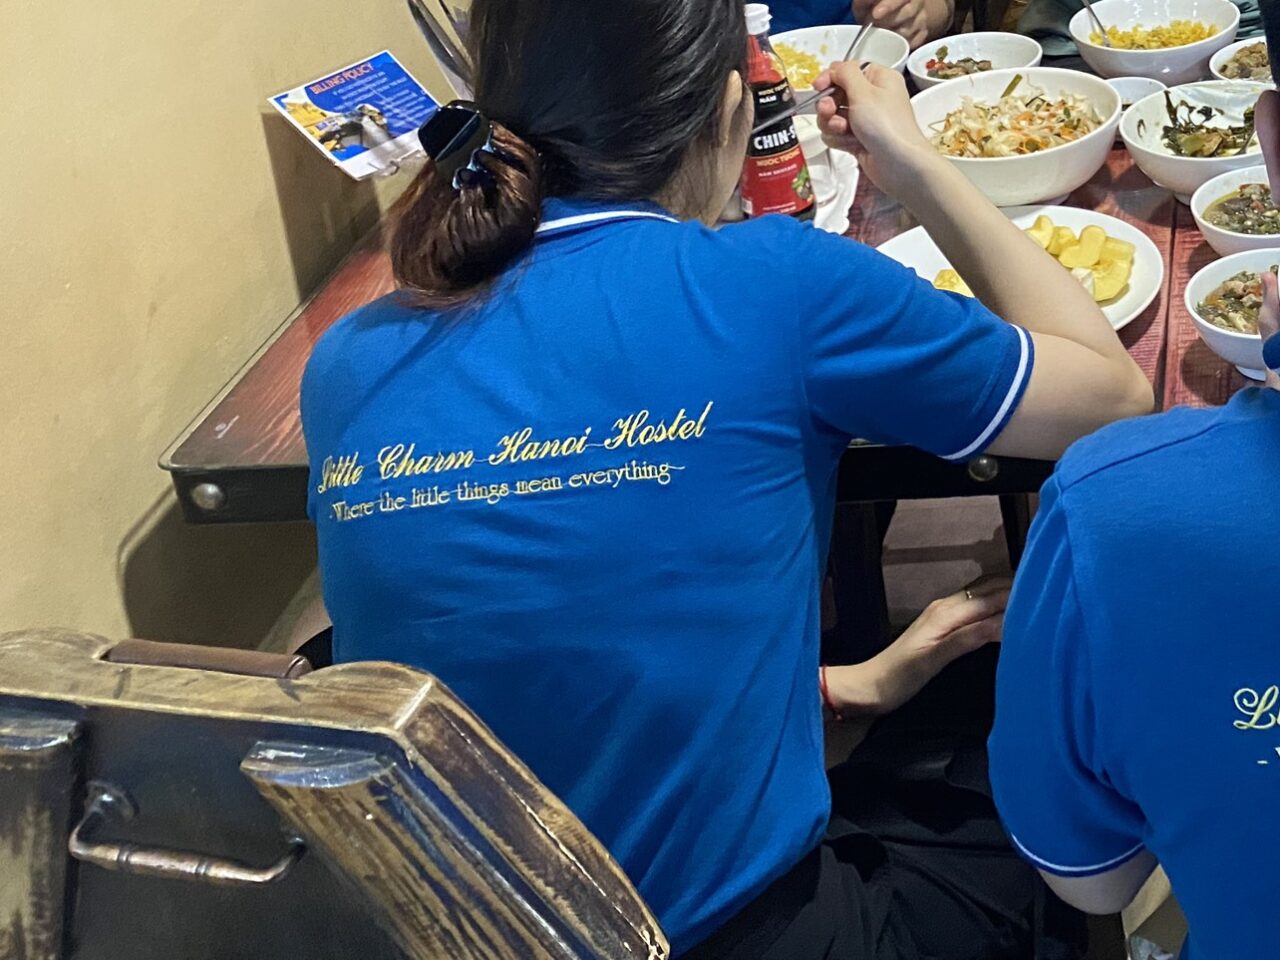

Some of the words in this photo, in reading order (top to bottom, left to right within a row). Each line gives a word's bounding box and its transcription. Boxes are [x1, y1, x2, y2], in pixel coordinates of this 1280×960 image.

[309, 72, 346, 95] BILLING
[343, 62, 374, 82] POLICY
[317, 451, 364, 494] Little
[378, 443, 475, 480] Charm
[488, 426, 592, 465] Hanoi
[604, 400, 713, 450] Hostel
[379, 491, 406, 512] the
[409, 486, 450, 508] little
[457, 481, 510, 505] things
[514, 477, 563, 494] mean
